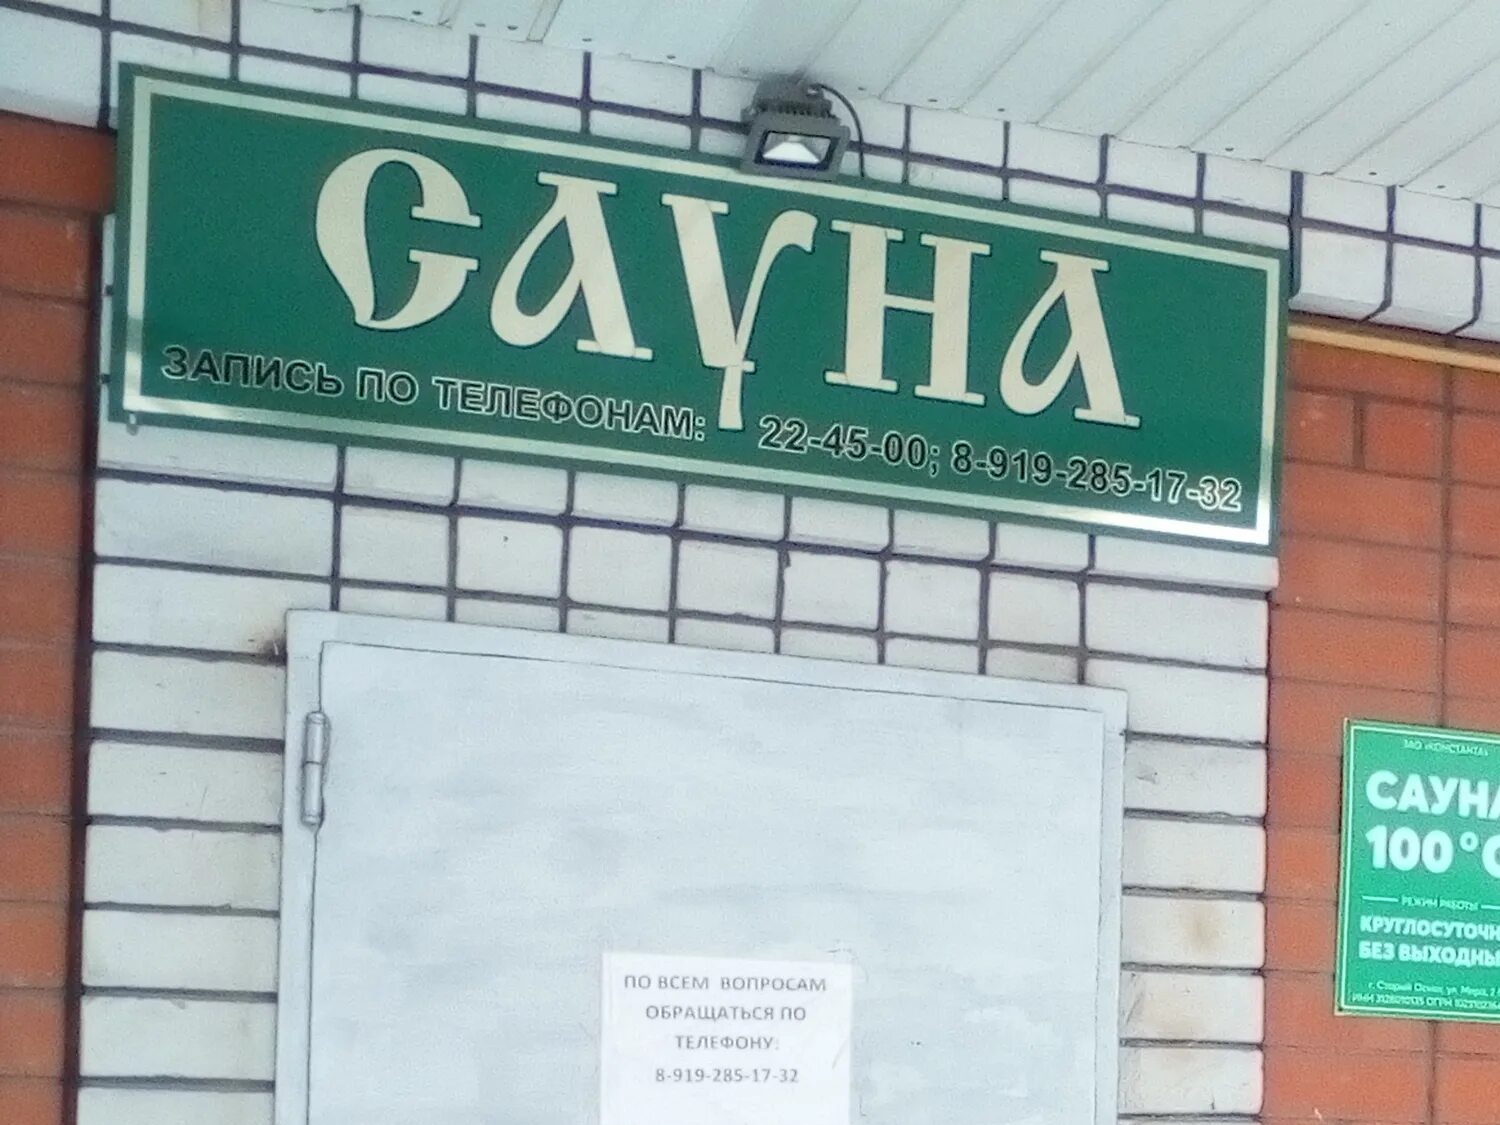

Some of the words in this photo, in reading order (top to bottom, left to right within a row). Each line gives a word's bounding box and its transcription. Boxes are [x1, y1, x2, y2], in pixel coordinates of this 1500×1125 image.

[314, 147, 1141, 430] САУНА
[161, 344, 344, 400] ЗАПИСЬ
[356, 368, 419, 406] ПО
[430, 375, 707, 442] ТЕЛЕФОНАМ:
[758, 412, 940, 478] 22-45-00;
[949, 440, 1242, 514] 8-919-285-17-32
[1401, 896, 1438, 907] РЕЖИМ
[1440, 899, 1479, 911] РАБОТЫ
[1358, 941, 1394, 959] БЕЗ
[624, 975, 650, 989] ПО
[657, 976, 709, 990] ВСЕМ
[720, 977, 826, 991] ВОПРОСАМ
[646, 1005, 774, 1021] ОБРАЩАТЬСЯ
[781, 1007, 806, 1021] ПО
[675, 1035, 779, 1050] ТЕЛЕФОНУ:
[655, 1069, 799, 1083] 8-919-285-17-32
